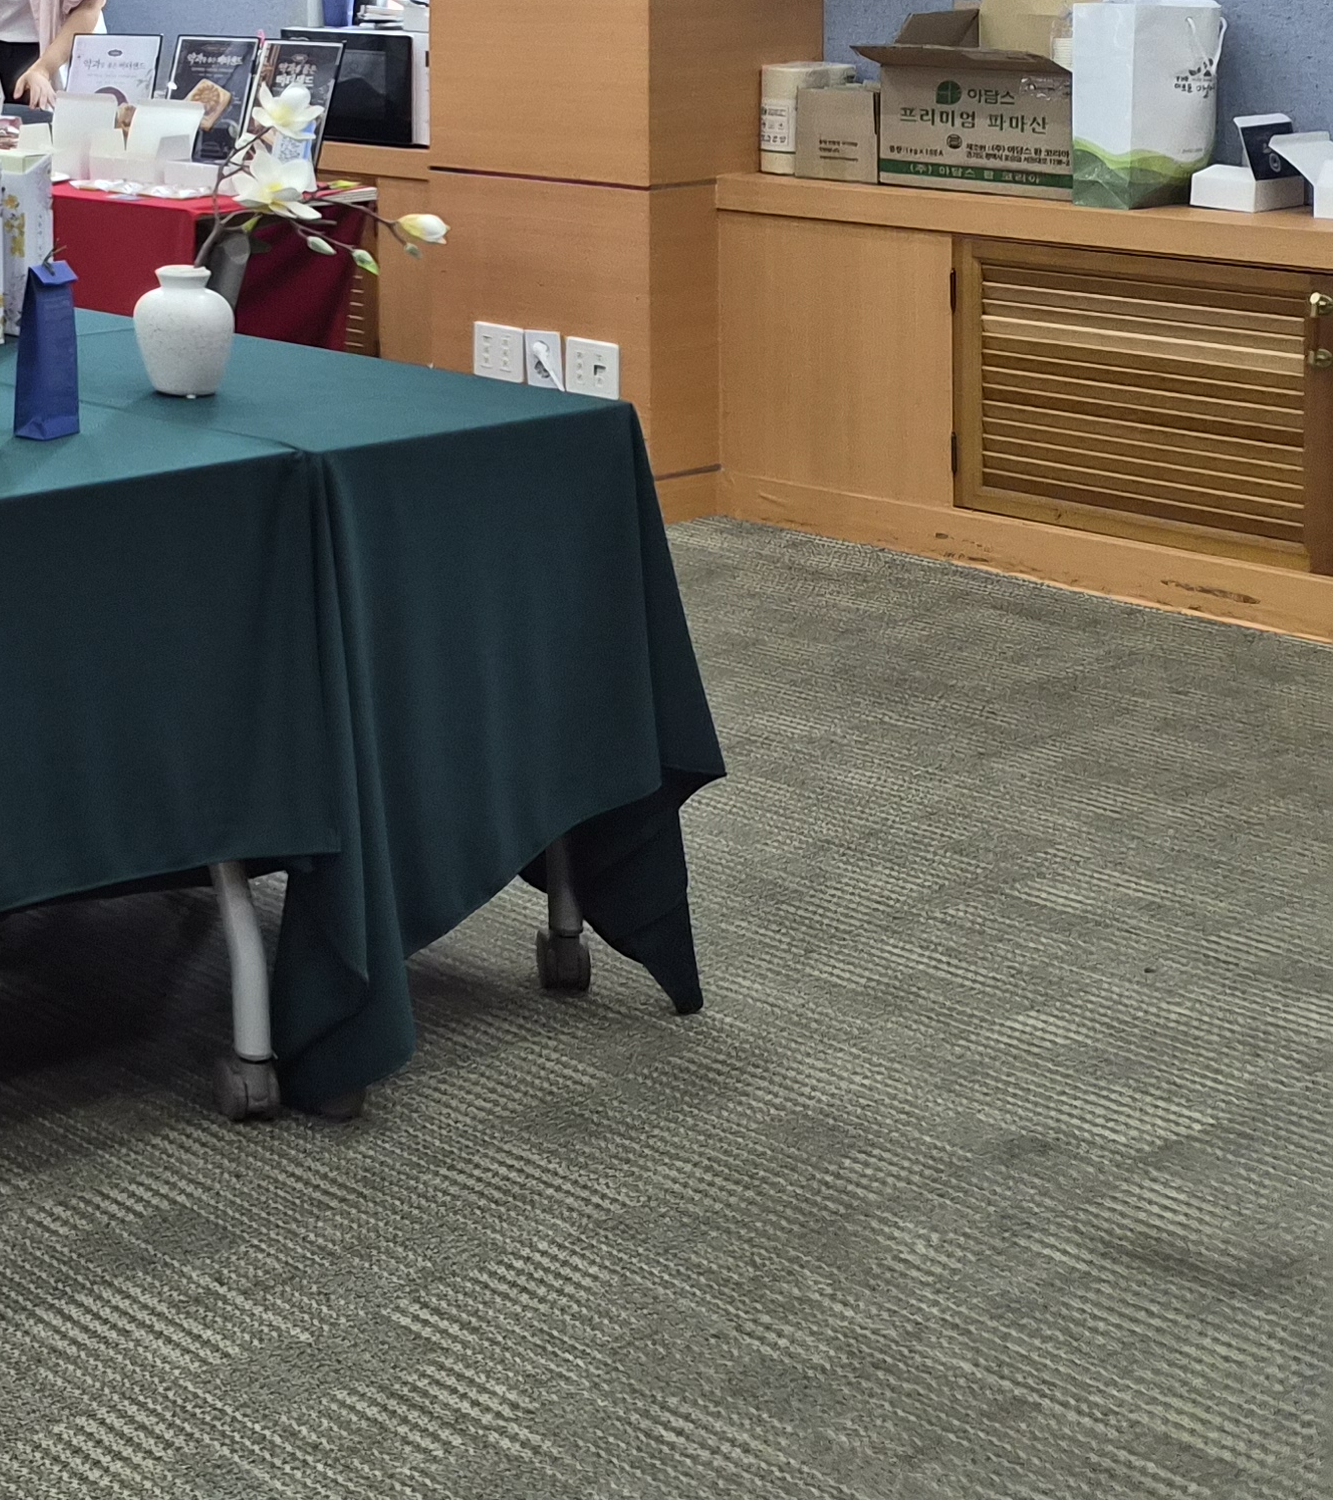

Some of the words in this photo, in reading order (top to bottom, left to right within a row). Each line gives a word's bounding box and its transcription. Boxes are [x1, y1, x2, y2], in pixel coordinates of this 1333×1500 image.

[967, 88, 1015, 105] 아담스
[900, 107, 976, 129] 프리미엄
[988, 113, 1048, 135] 파마산
[909, 163, 933, 174] (주)
[939, 166, 975, 177] 아담스
[1002, 172, 1040, 184] 코리아
